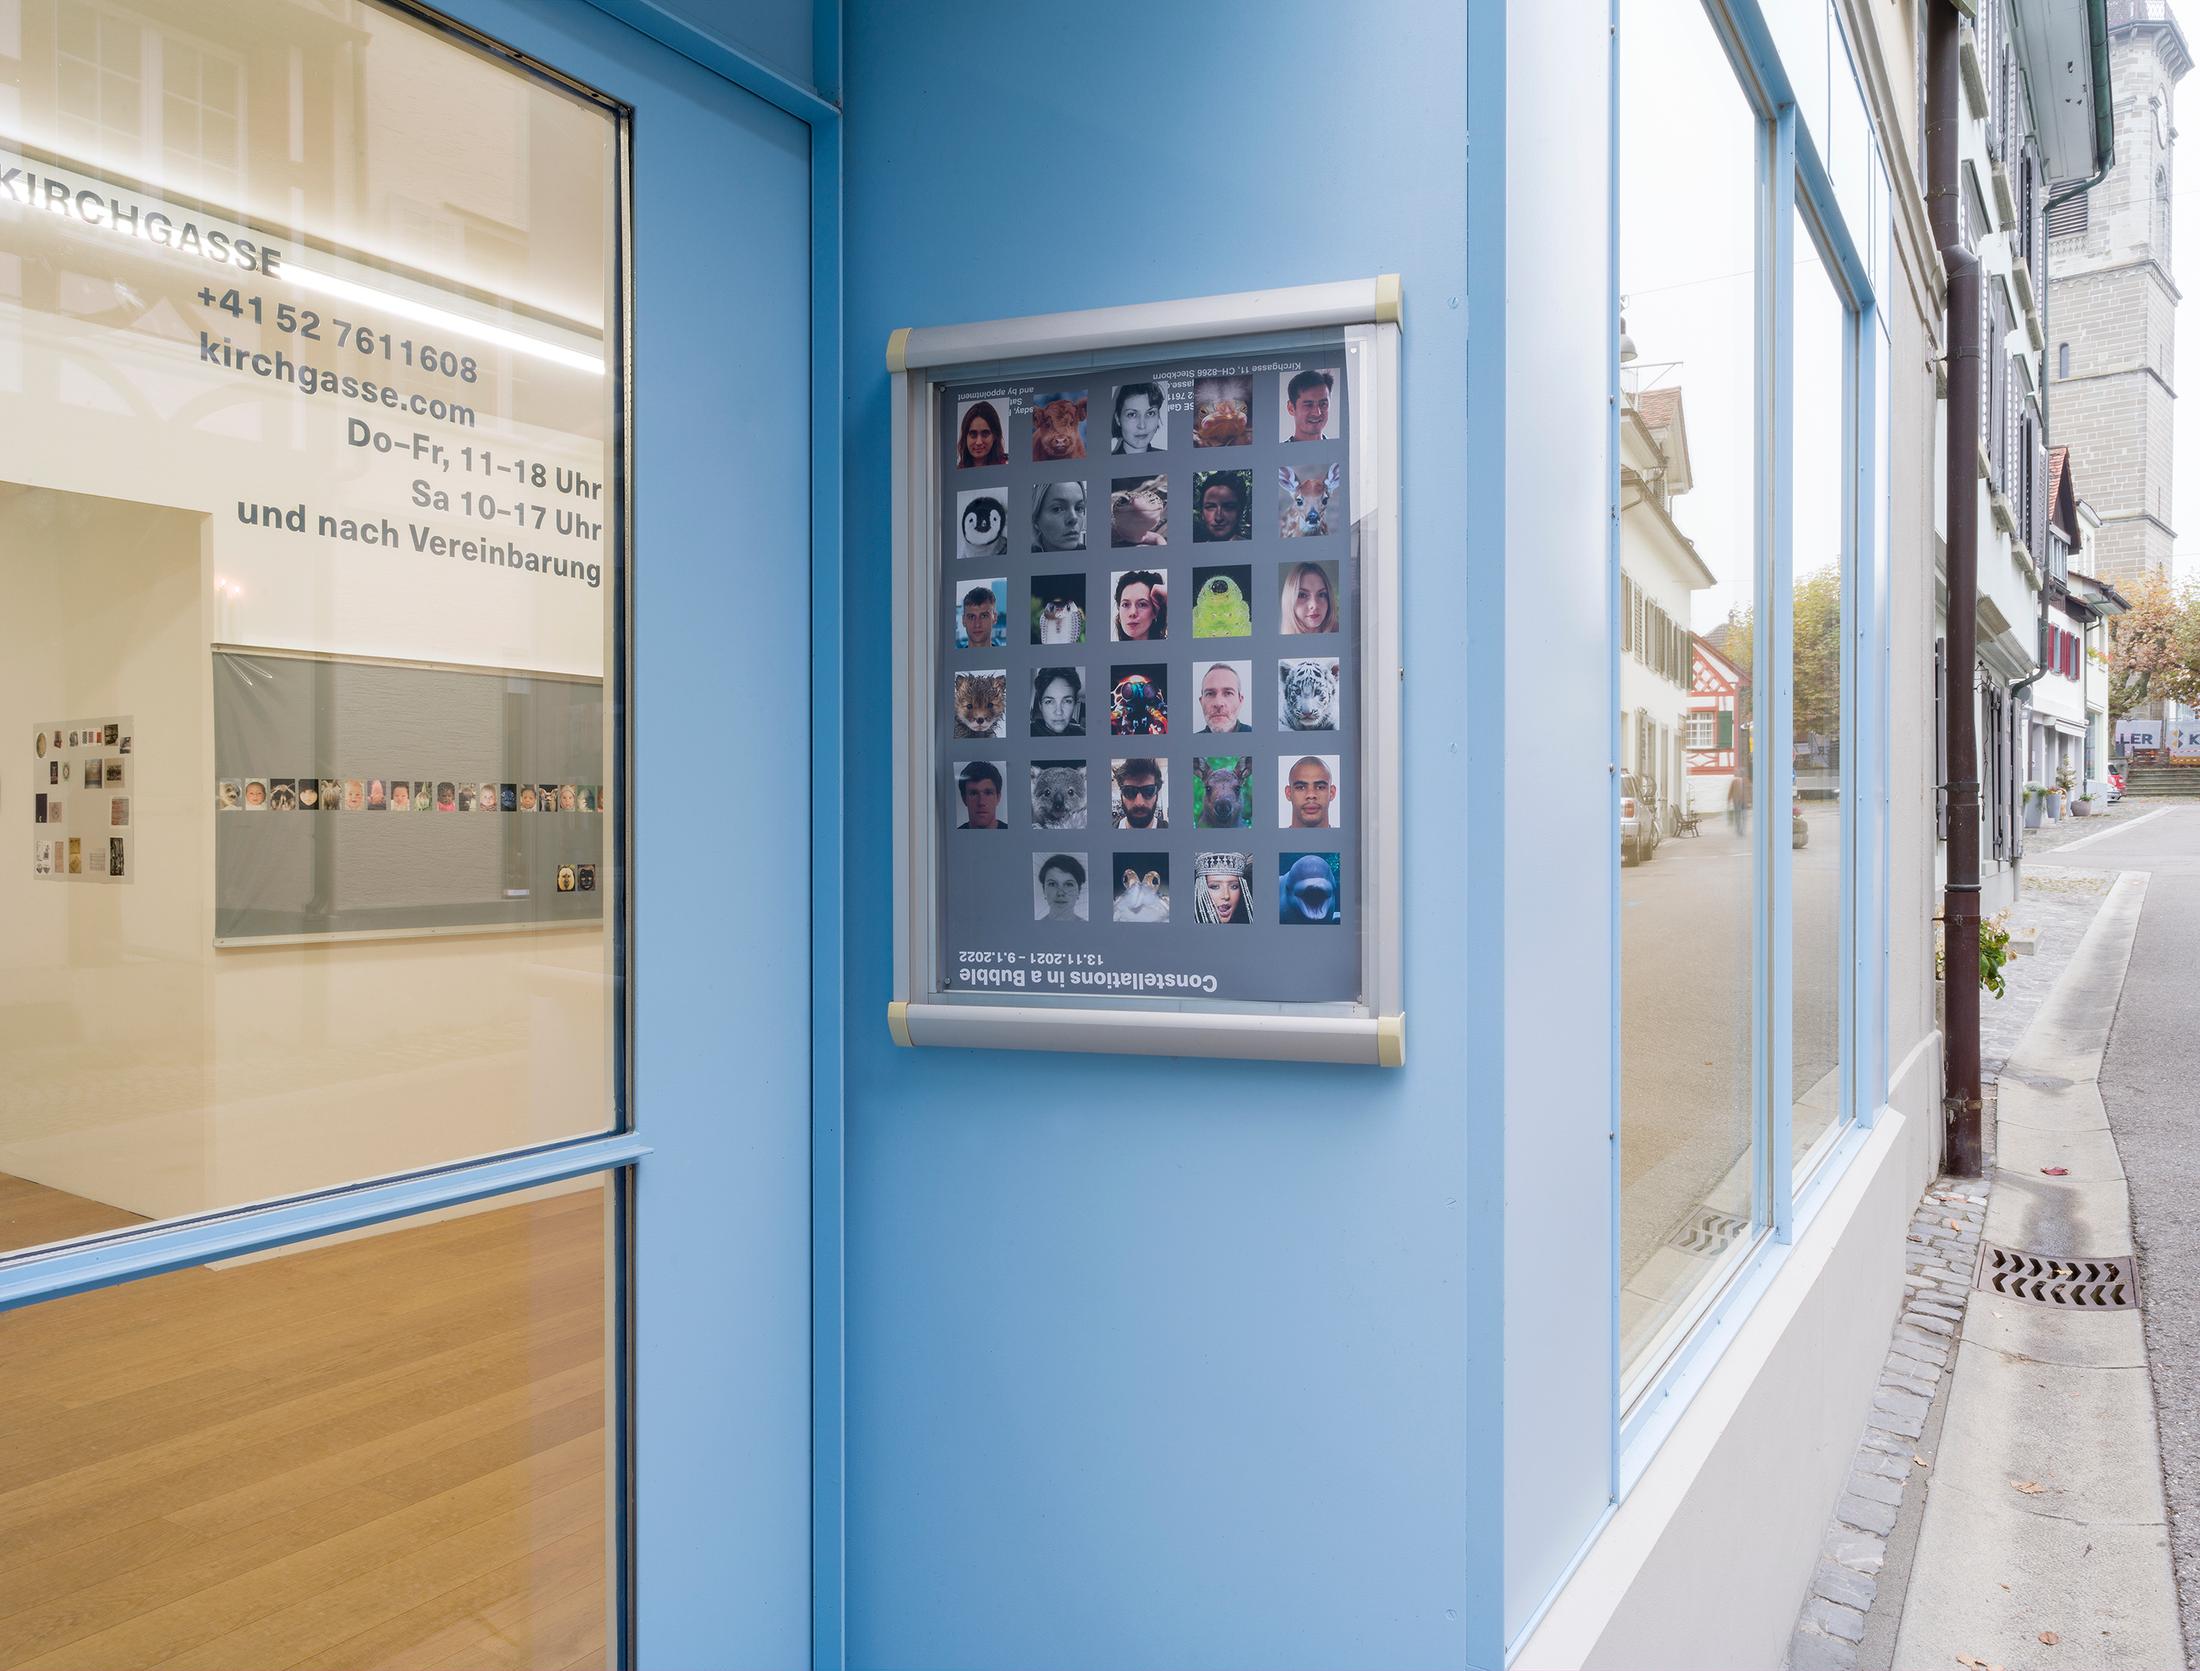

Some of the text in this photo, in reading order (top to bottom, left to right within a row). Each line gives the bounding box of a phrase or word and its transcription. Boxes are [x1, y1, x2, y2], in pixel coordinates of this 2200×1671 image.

[0, 162, 282, 280] KIRCHGASSE
[197, 286, 263, 325] +41
[276, 302, 321, 342] 52
[199, 330, 476, 428] kirchgasse.com
[1153, 369, 1196, 380] Steckborn
[1252, 362, 1302, 373] Kirchgasse
[958, 386, 1035, 401] and by appointment
[555, 466, 602, 501] Uhr
[411, 478, 449, 512] Sa
[555, 508, 602, 542] Uhr
[237, 501, 601, 589] und nach Vereinbarung
[959, 951, 1016, 964] 9.1.2022
[1030, 952, 1104, 966] 13.11.2021
[959, 968, 1218, 993] Constellations in a Bubble
